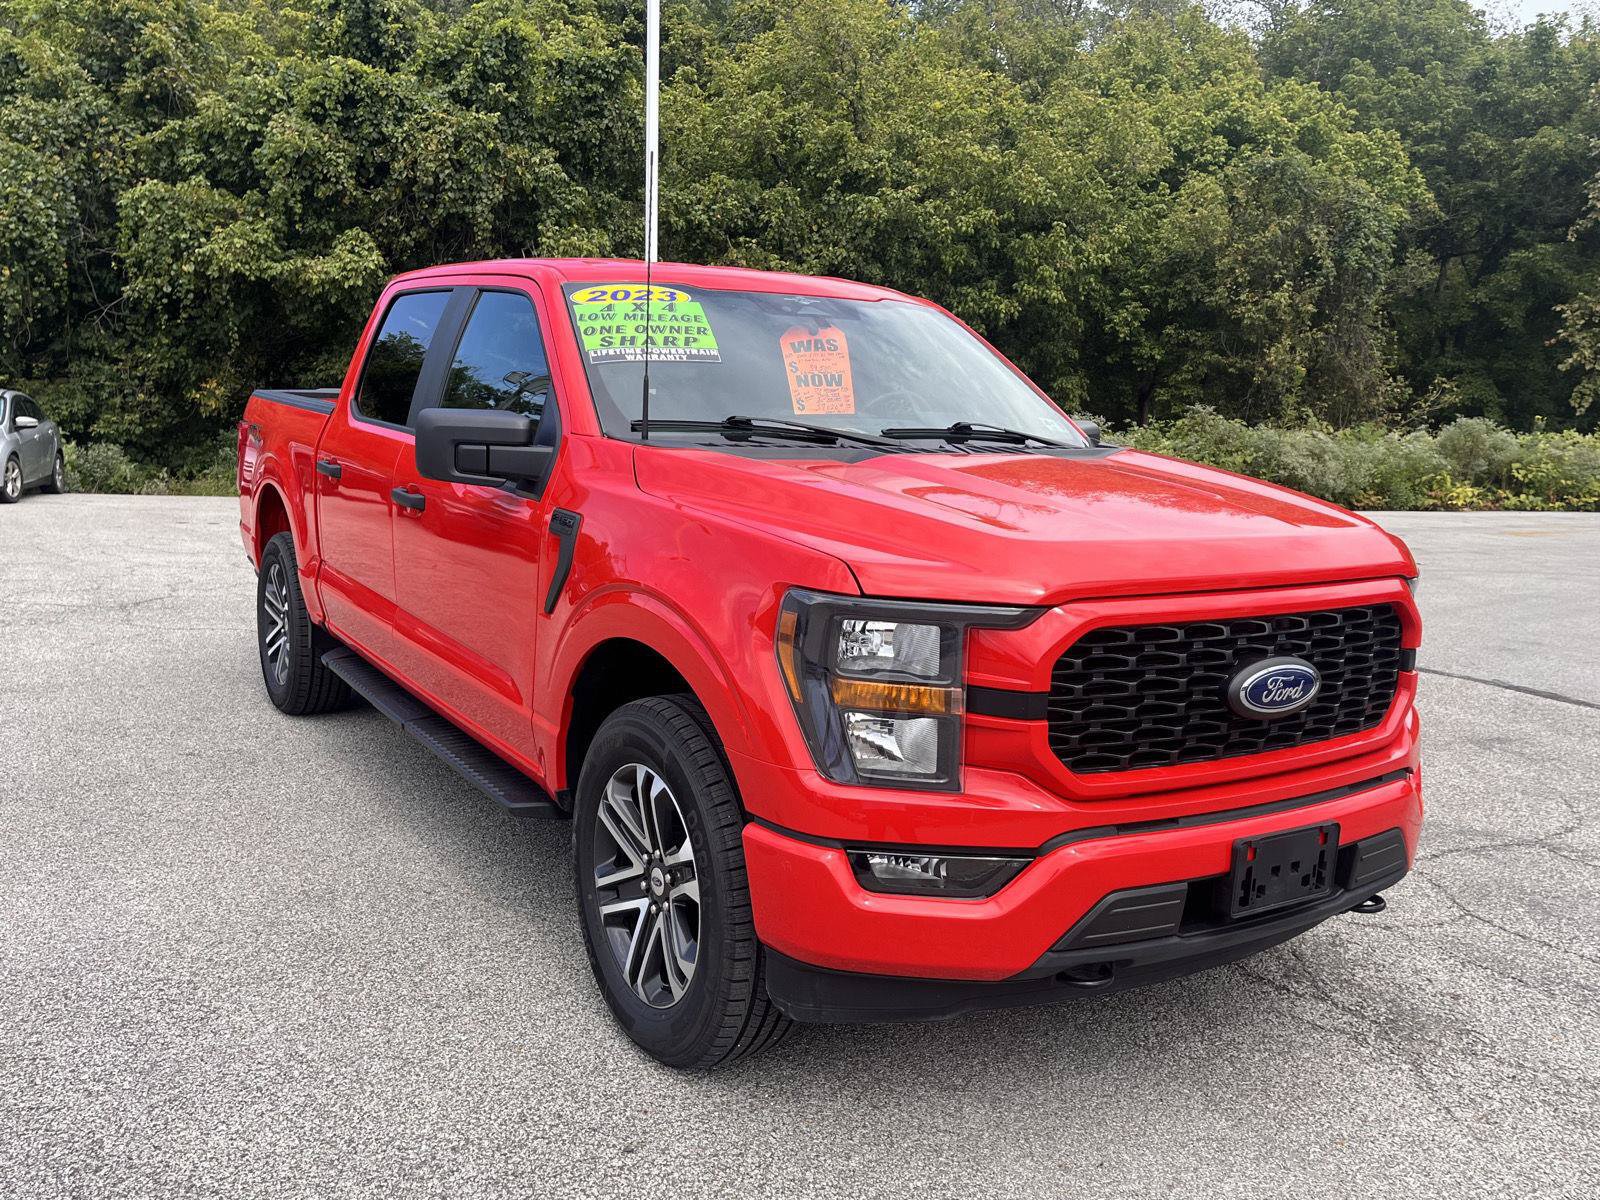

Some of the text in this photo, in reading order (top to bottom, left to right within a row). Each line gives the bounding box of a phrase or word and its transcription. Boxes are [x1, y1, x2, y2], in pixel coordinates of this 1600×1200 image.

[586, 289, 678, 302] 2023
[600, 302, 615, 312] 4
[662, 302, 677, 312] 4
[578, 312, 704, 323] LOW MILEAGE
[583, 324, 708, 336] ONE OWNER
[600, 335, 699, 347] SHARP
[789, 338, 839, 353] WAS
[590, 348, 643, 357] LIFETIME
[625, 353, 687, 361] WARRANTY
[795, 373, 843, 388] NOW
[1262, 675, 1305, 703] Ford
